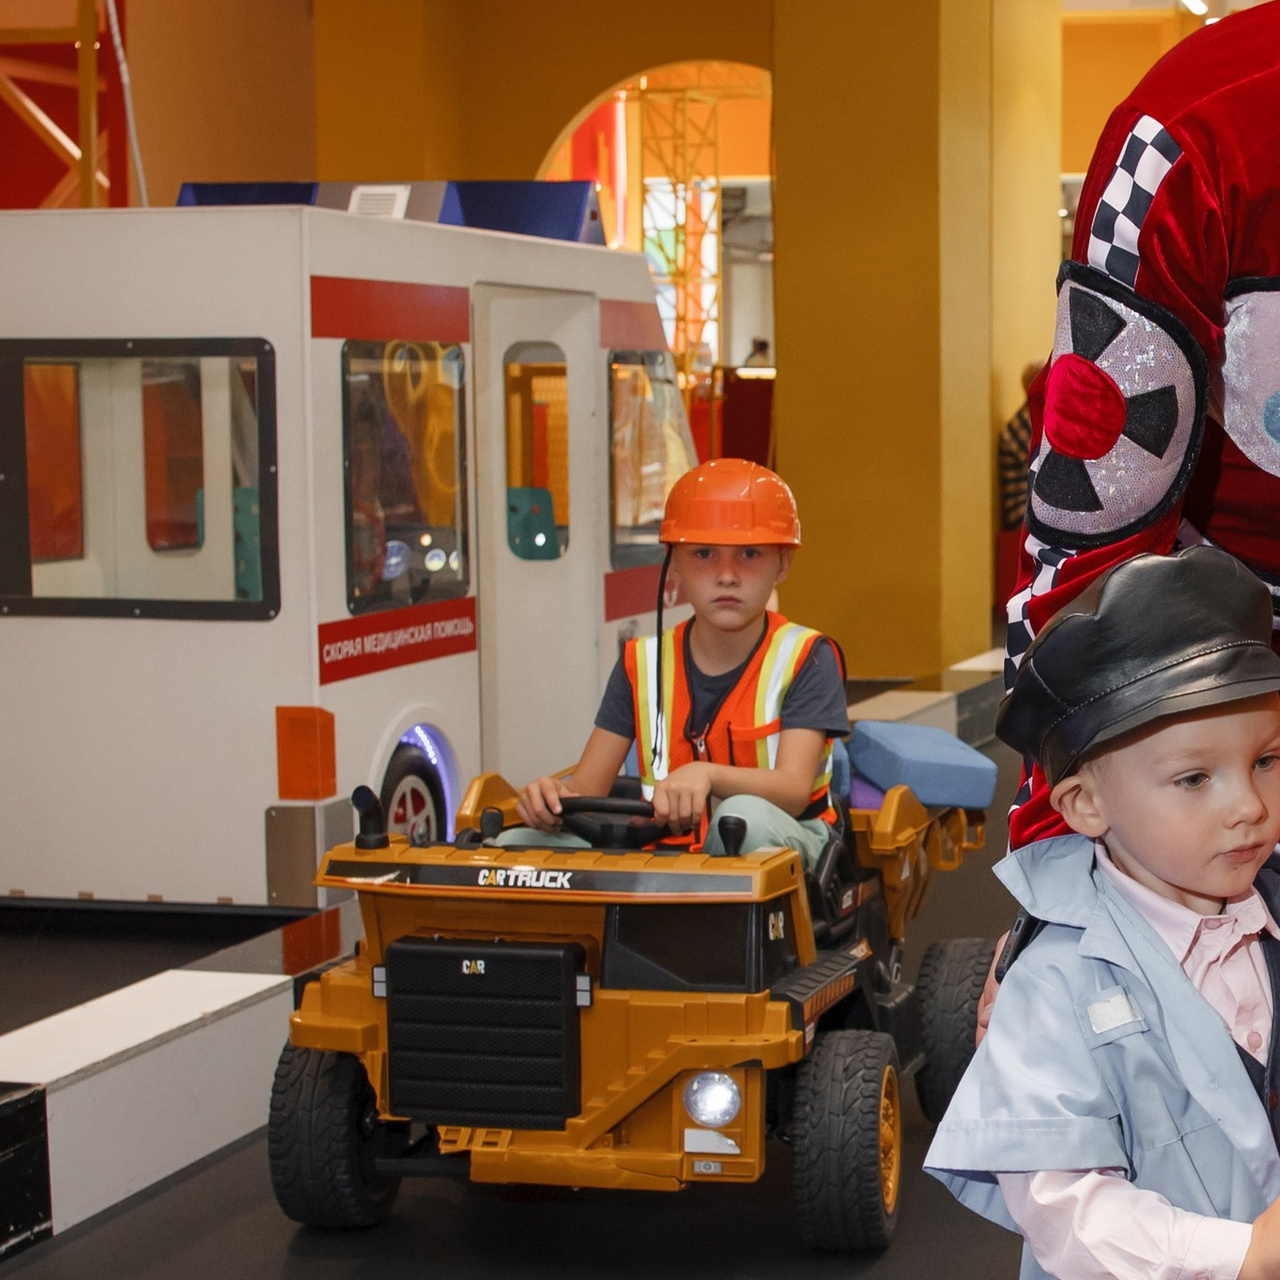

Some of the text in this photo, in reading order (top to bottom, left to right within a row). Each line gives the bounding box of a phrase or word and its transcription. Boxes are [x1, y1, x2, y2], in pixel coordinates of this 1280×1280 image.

[323, 617, 474, 663] СКОРАЯ МЕДИЦИНСКАЯ ПОМОЩЬ
[462, 959, 486, 975] CAR
